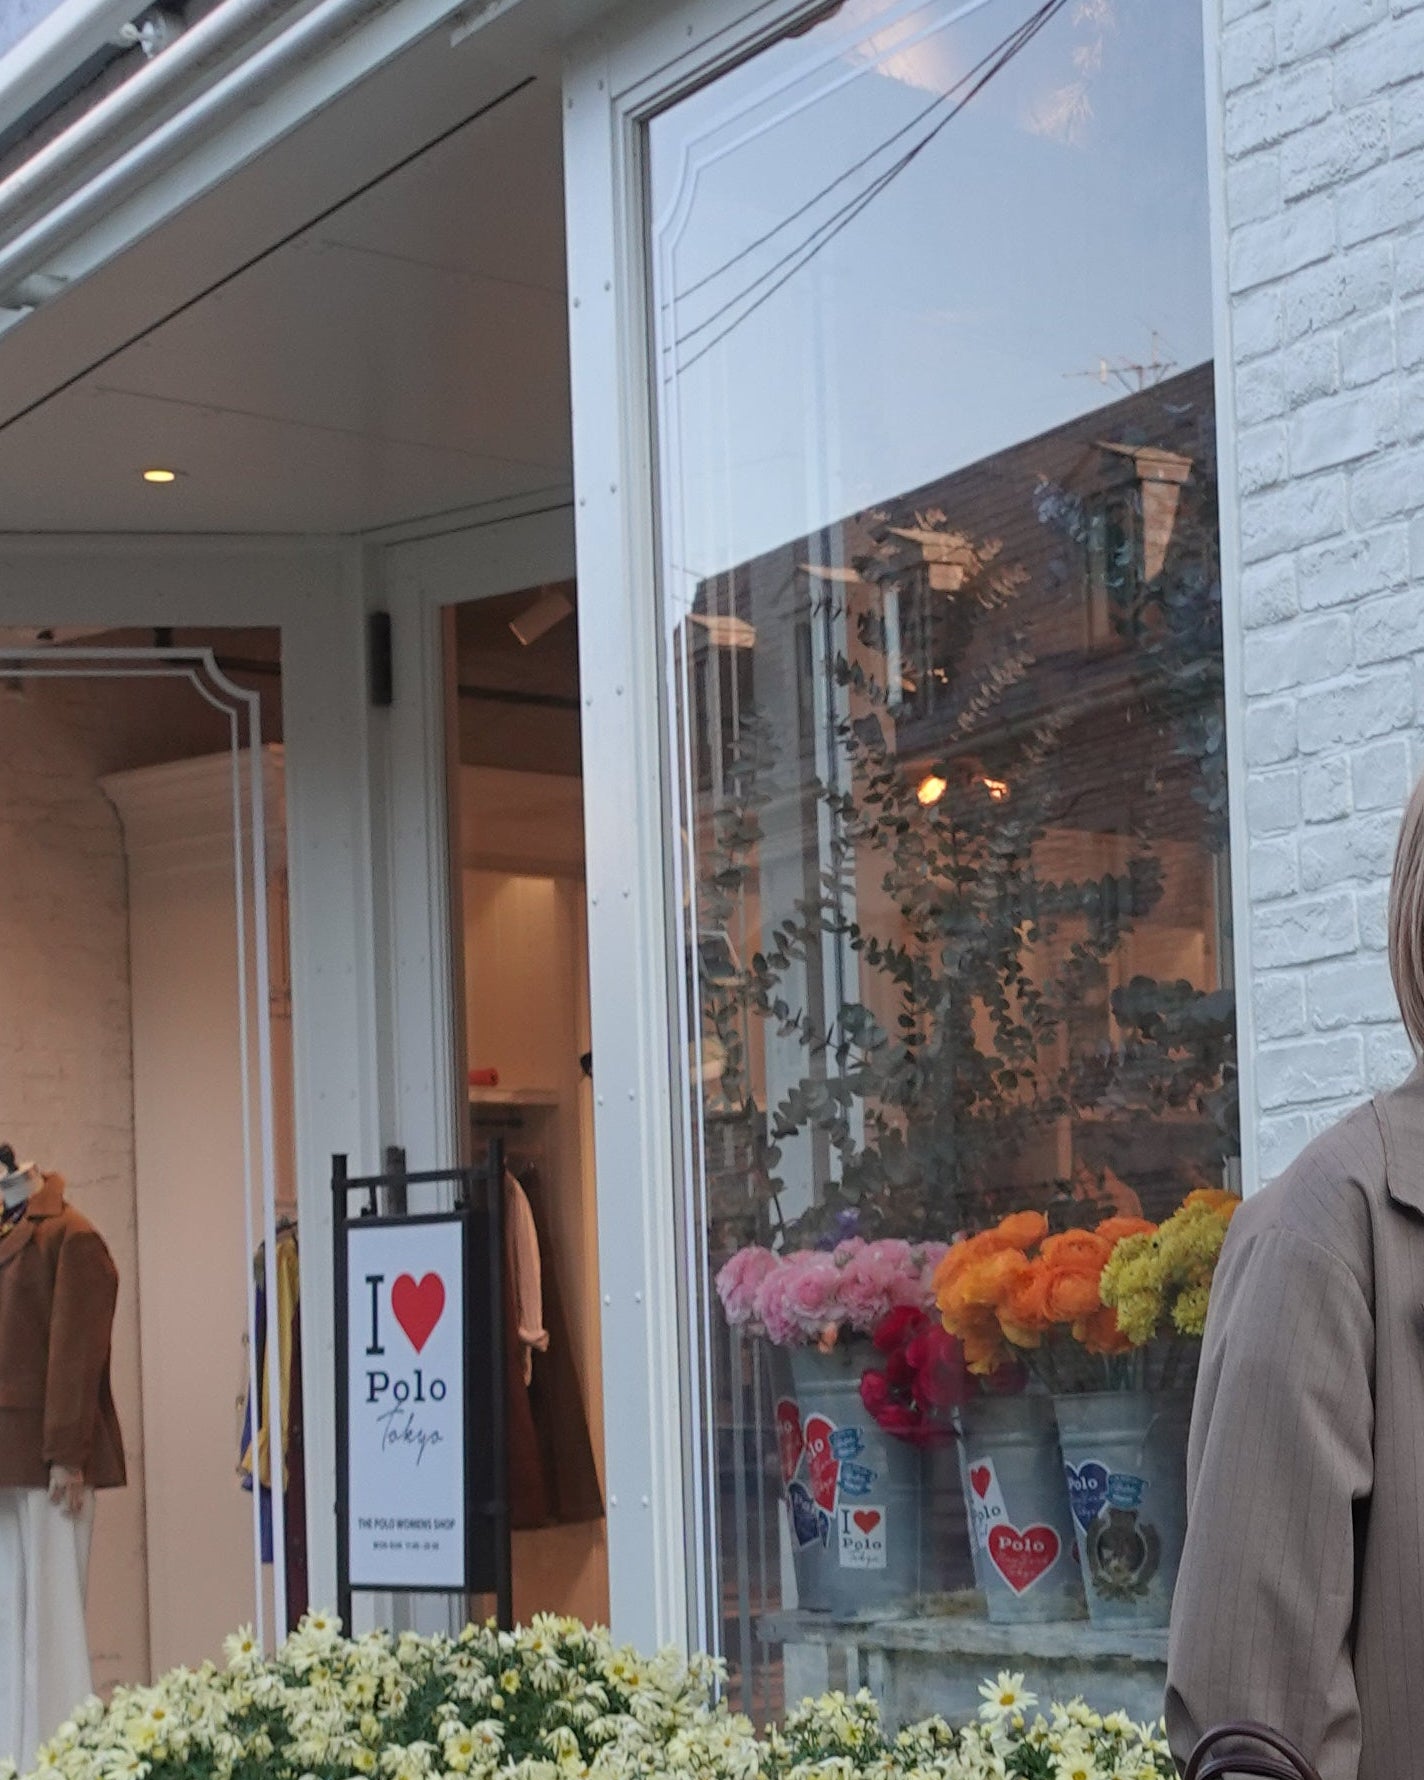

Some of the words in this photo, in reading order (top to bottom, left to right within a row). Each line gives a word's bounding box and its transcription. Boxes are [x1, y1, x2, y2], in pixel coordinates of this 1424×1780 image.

[365, 1275, 385, 1356] I
[365, 1369, 447, 1403] Polo
[376, 1401, 444, 1466] Tokyo
[842, 1538, 882, 1551] Polo
[998, 1535, 1046, 1552] Polo
